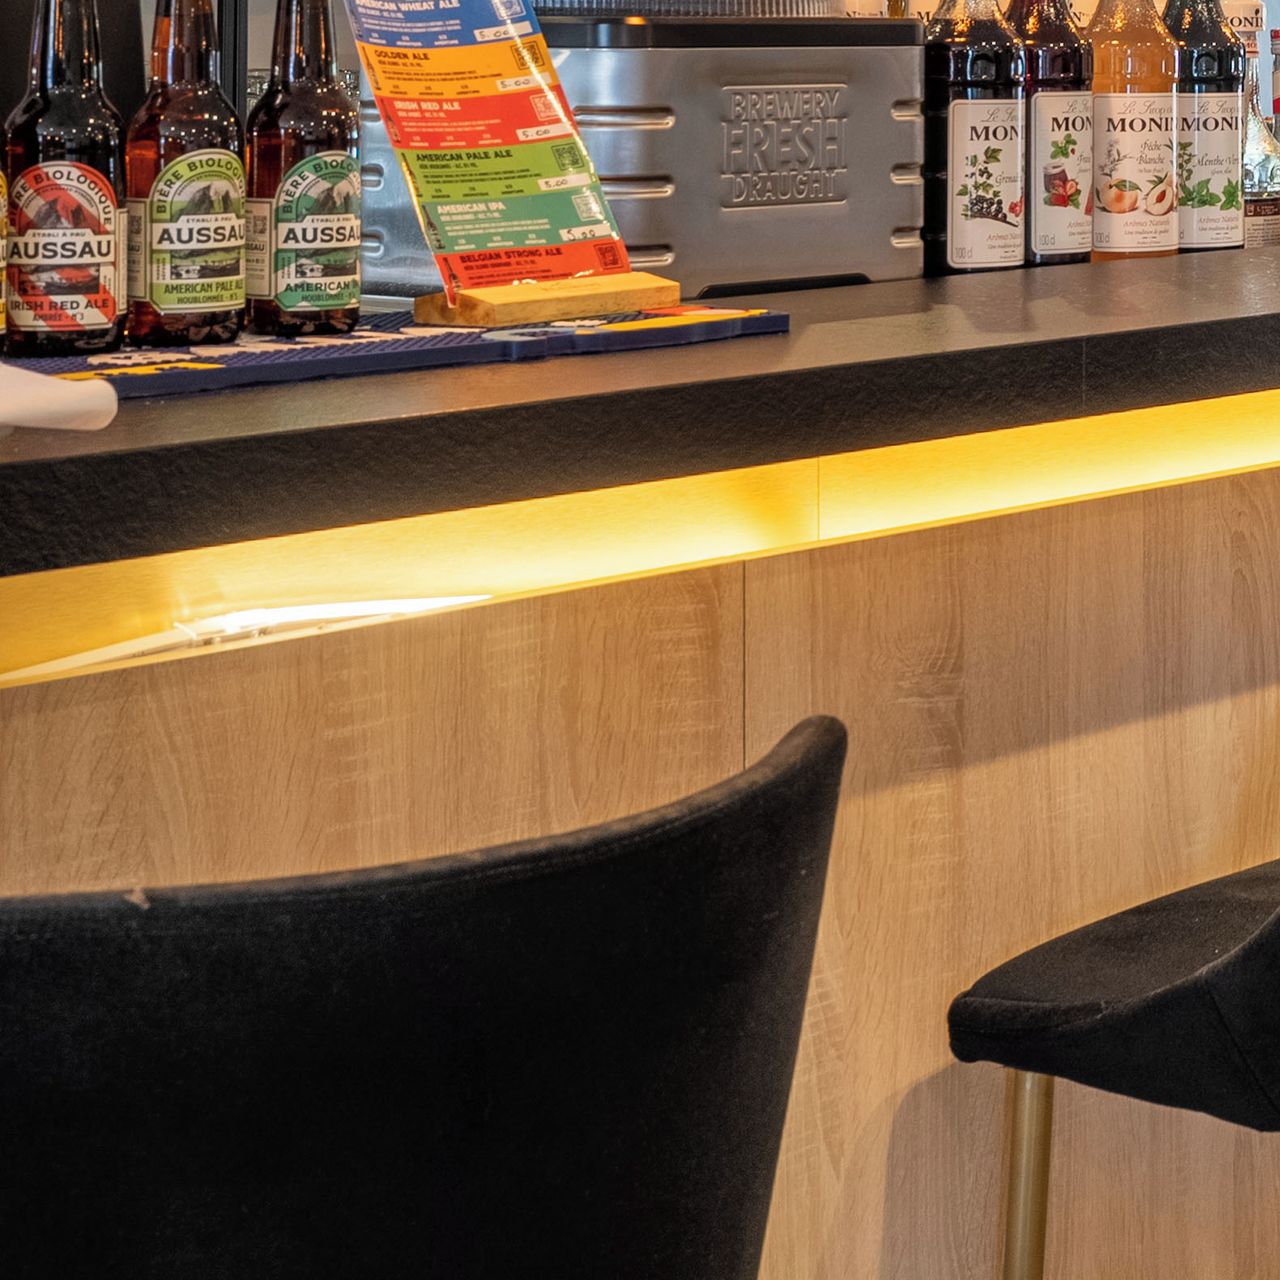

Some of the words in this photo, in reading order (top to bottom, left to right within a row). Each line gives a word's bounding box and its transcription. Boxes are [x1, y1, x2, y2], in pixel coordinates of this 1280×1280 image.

[400, 1, 436, 12] WHEAT
[439, 0, 461, 9] ALE
[1229, 16, 1263, 28] ONI
[374, 50, 410, 61] GOLDEN
[412, 51, 431, 61] ALE
[500, 79, 530, 89] 5.00
[393, 101, 419, 111] IRISH
[421, 101, 441, 111] RED
[442, 101, 461, 111] ALE
[731, 90, 840, 121] BREWERY
[1051, 115, 1092, 132] MON
[1181, 115, 1244, 133] MONI
[521, 129, 551, 139] 5.00
[969, 125, 1024, 142] MON
[720, 120, 848, 173] FRESH
[415, 153, 465, 162] AMERICAN
[466, 151, 492, 161] PALE
[493, 149, 513, 159] ALE
[156, 170, 184, 214] BIÈRE
[282, 170, 310, 214] BIÈRE
[732, 173, 837, 202] DRAUGHT
[33, 169, 113, 226] BIOLOGIQUE
[437, 202, 488, 214] AMERICAN
[488, 201, 507, 211] IPA
[9, 239, 112, 260] AUSSAU
[459, 253, 502, 264] BELGIAN
[504, 249, 543, 260] STRONG
[544, 247, 563, 257] ALE
[164, 282, 213, 295] AMERICAN
[215, 281, 234, 292] PALE
[284, 280, 350, 293] AMERICAN
[10, 299, 44, 311] IRISH
[48, 299, 80, 311] RED
[84, 298, 110, 310] ALE
